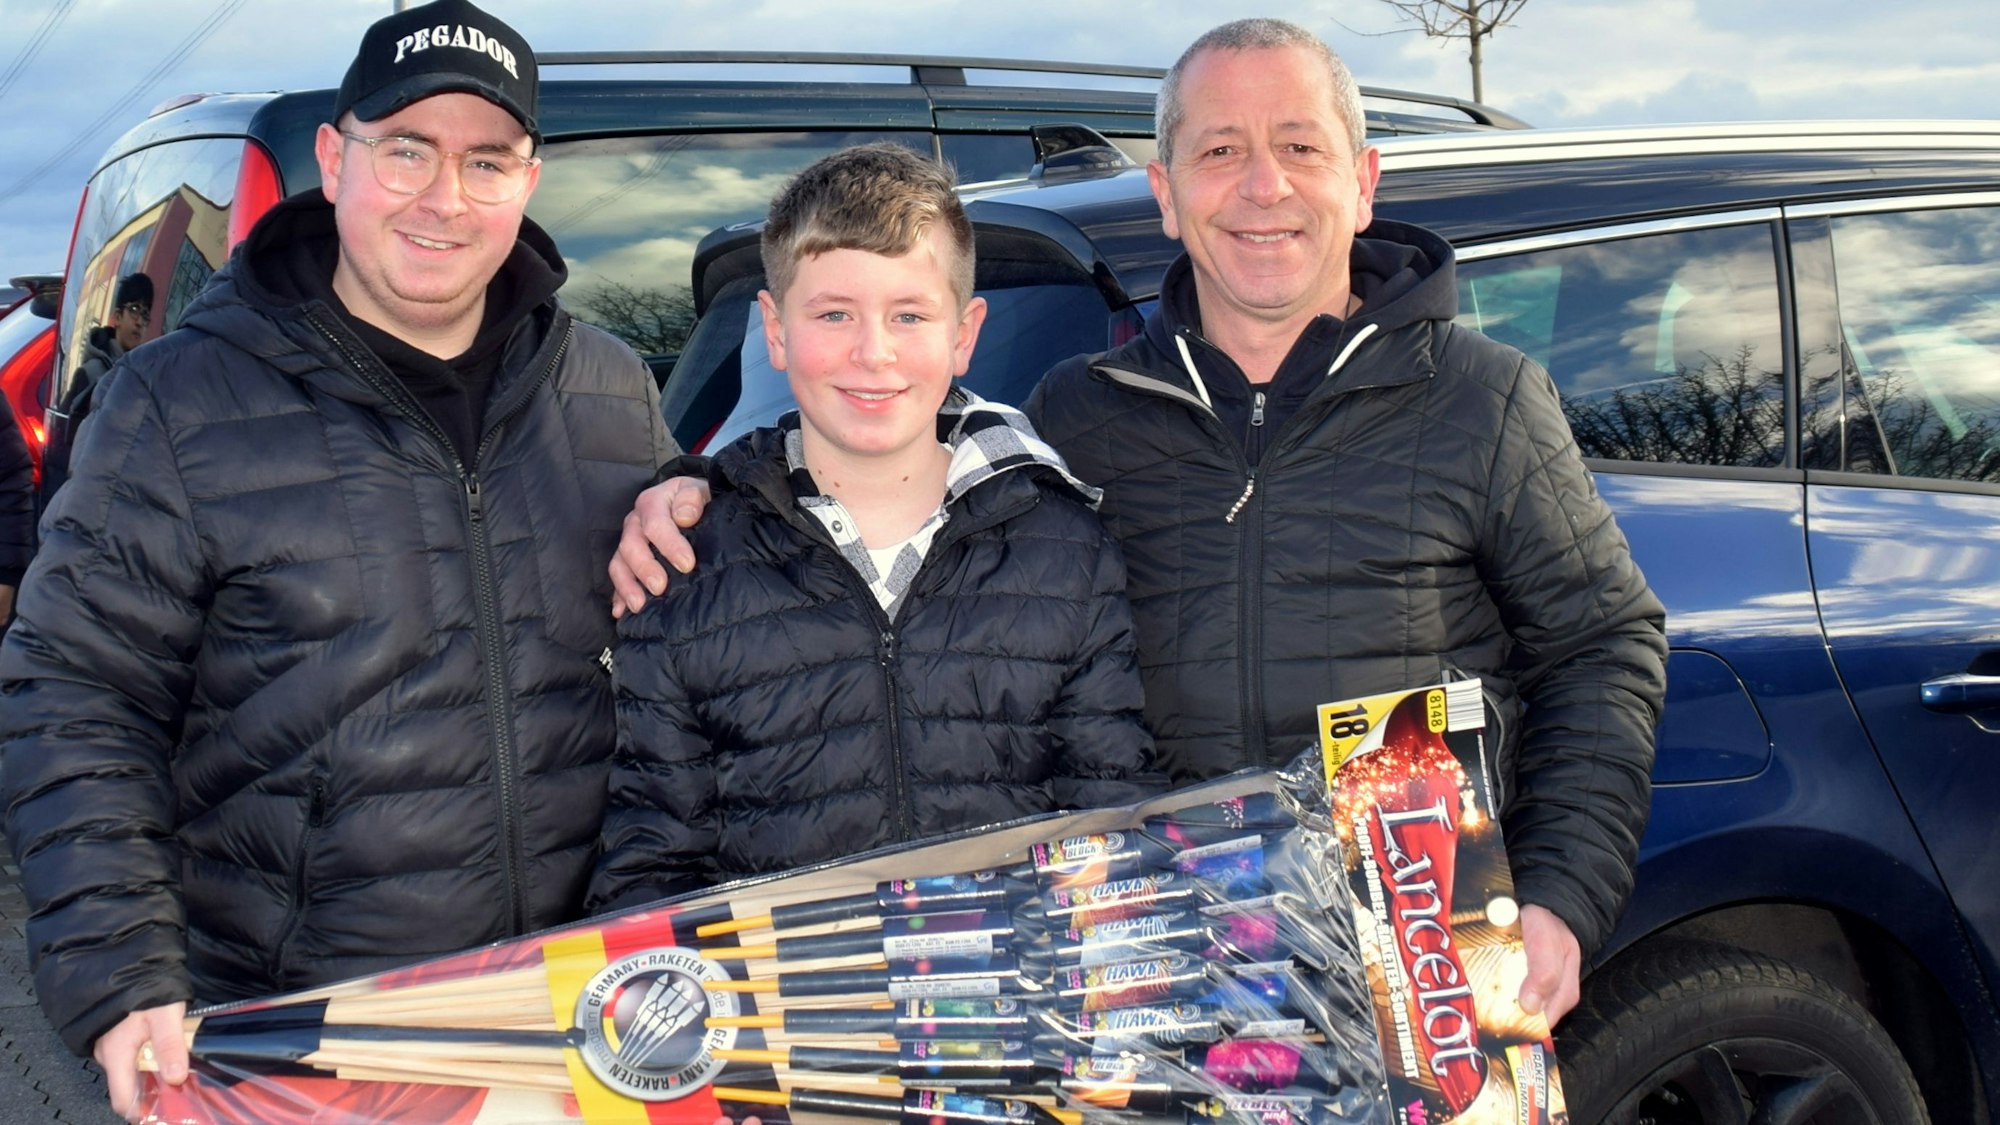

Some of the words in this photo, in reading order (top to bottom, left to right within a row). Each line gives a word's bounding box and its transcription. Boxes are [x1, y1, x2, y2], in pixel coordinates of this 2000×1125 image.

[394, 24, 519, 79] PEGADOR
[1330, 704, 1369, 739] 18
[1429, 695, 1443, 728] 8148
[1093, 879, 1144, 897] HAWK
[1353, 815, 1420, 1078] PROFI-BOMBEN-RAKETEN-SORTIMENT
[1375, 795, 1484, 1077] Lancelot
[588, 959, 640, 1007] GERMANY
[649, 954, 707, 976] RAKETEN
[1104, 961, 1157, 981] HAWK
[609, 1063, 670, 1091] RAKETEN
[1516, 1067, 1529, 1123] GERMANY
[1532, 1052, 1546, 1107] RAKETEN
